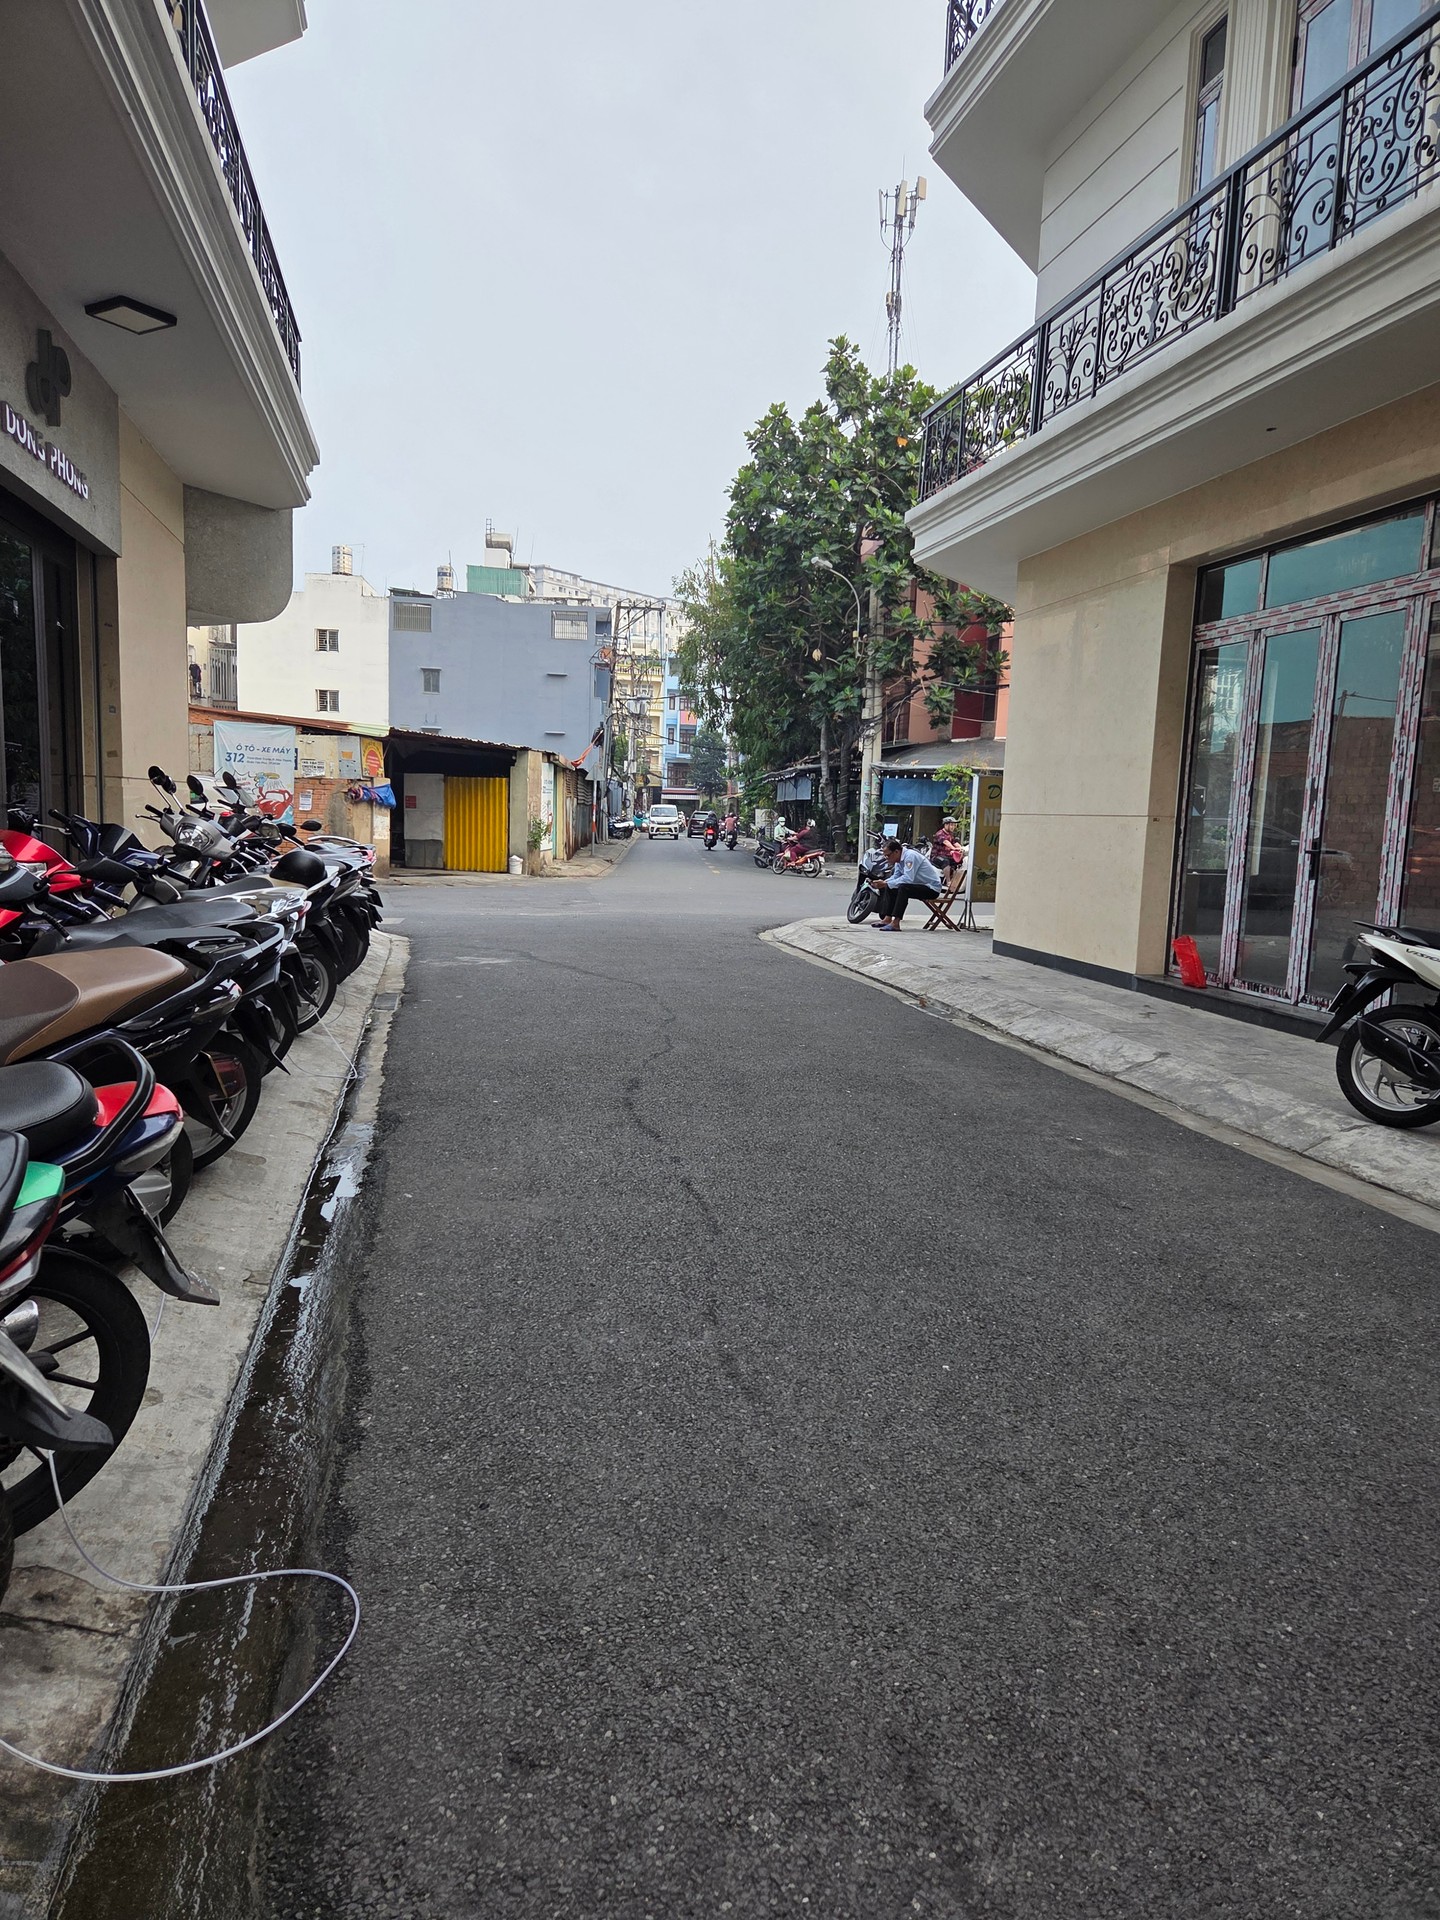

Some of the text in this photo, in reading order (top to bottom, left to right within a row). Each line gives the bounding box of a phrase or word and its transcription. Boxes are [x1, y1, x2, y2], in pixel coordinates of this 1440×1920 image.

[272, 746, 291, 754] MÁY
[225, 751, 245, 763] 312
[1406, 948, 1440, 963] VISIO
